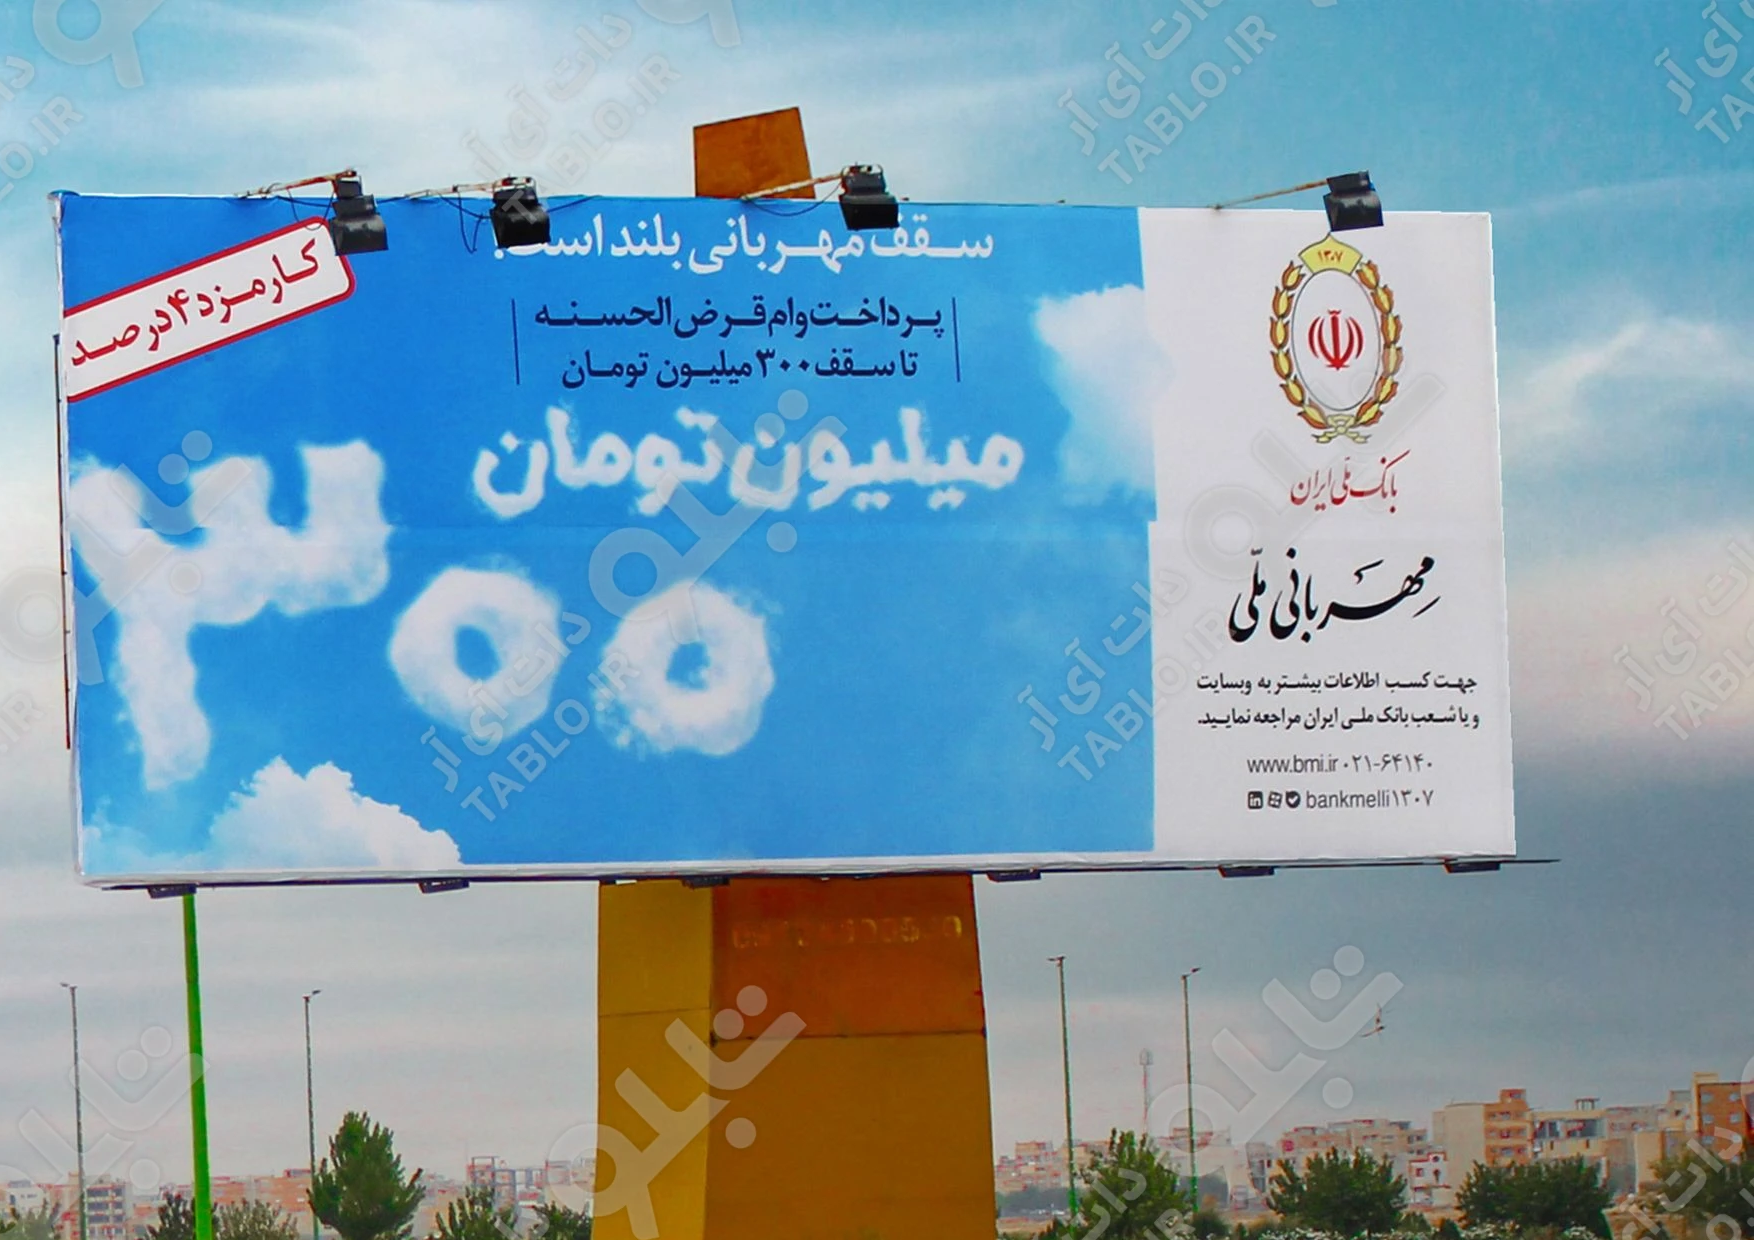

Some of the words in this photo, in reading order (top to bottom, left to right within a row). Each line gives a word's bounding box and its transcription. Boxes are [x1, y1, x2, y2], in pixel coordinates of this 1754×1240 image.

[609, 212, 683, 271] بلند
[688, 212, 866, 275] مهربانی
[195, 238, 320, 323] کارمزد
[167, 287, 191, 326] ۴
[534, 295, 672, 327] الحسنه
[673, 294, 767, 339] قرض
[767, 296, 808, 338] وام
[809, 296, 945, 338] پرداخت
[71, 309, 172, 367] درصد
[561, 350, 650, 389] تومان
[656, 349, 753, 389] میلیون
[755, 347, 811, 379] ۳۰۰
[814, 348, 896, 378] سقف
[899, 349, 919, 378] تا
[472, 405, 725, 518] تومان
[728, 405, 1024, 513] میلیون
[1290, 467, 1333, 512] ایران
[1350, 449, 1412, 514] بانک
[1197, 672, 1252, 695] وبسایت
[1257, 676, 1272, 694] به
[1274, 673, 1322, 695] بیشتر
[1324, 672, 1380, 689] اطلاعات
[1385, 671, 1431, 693] کسب
[1433, 674, 1477, 694] جهت
[1253, 707, 1302, 730] مراجعه
[1303, 706, 1339, 730] ایران
[1340, 706, 1374, 730] ملی
[1376, 706, 1409, 728] بانک
[1411, 704, 1456, 728] شعب
[1458, 706, 1470, 727] یا
[1246, 754, 1339, 774] www.bmi.ir
